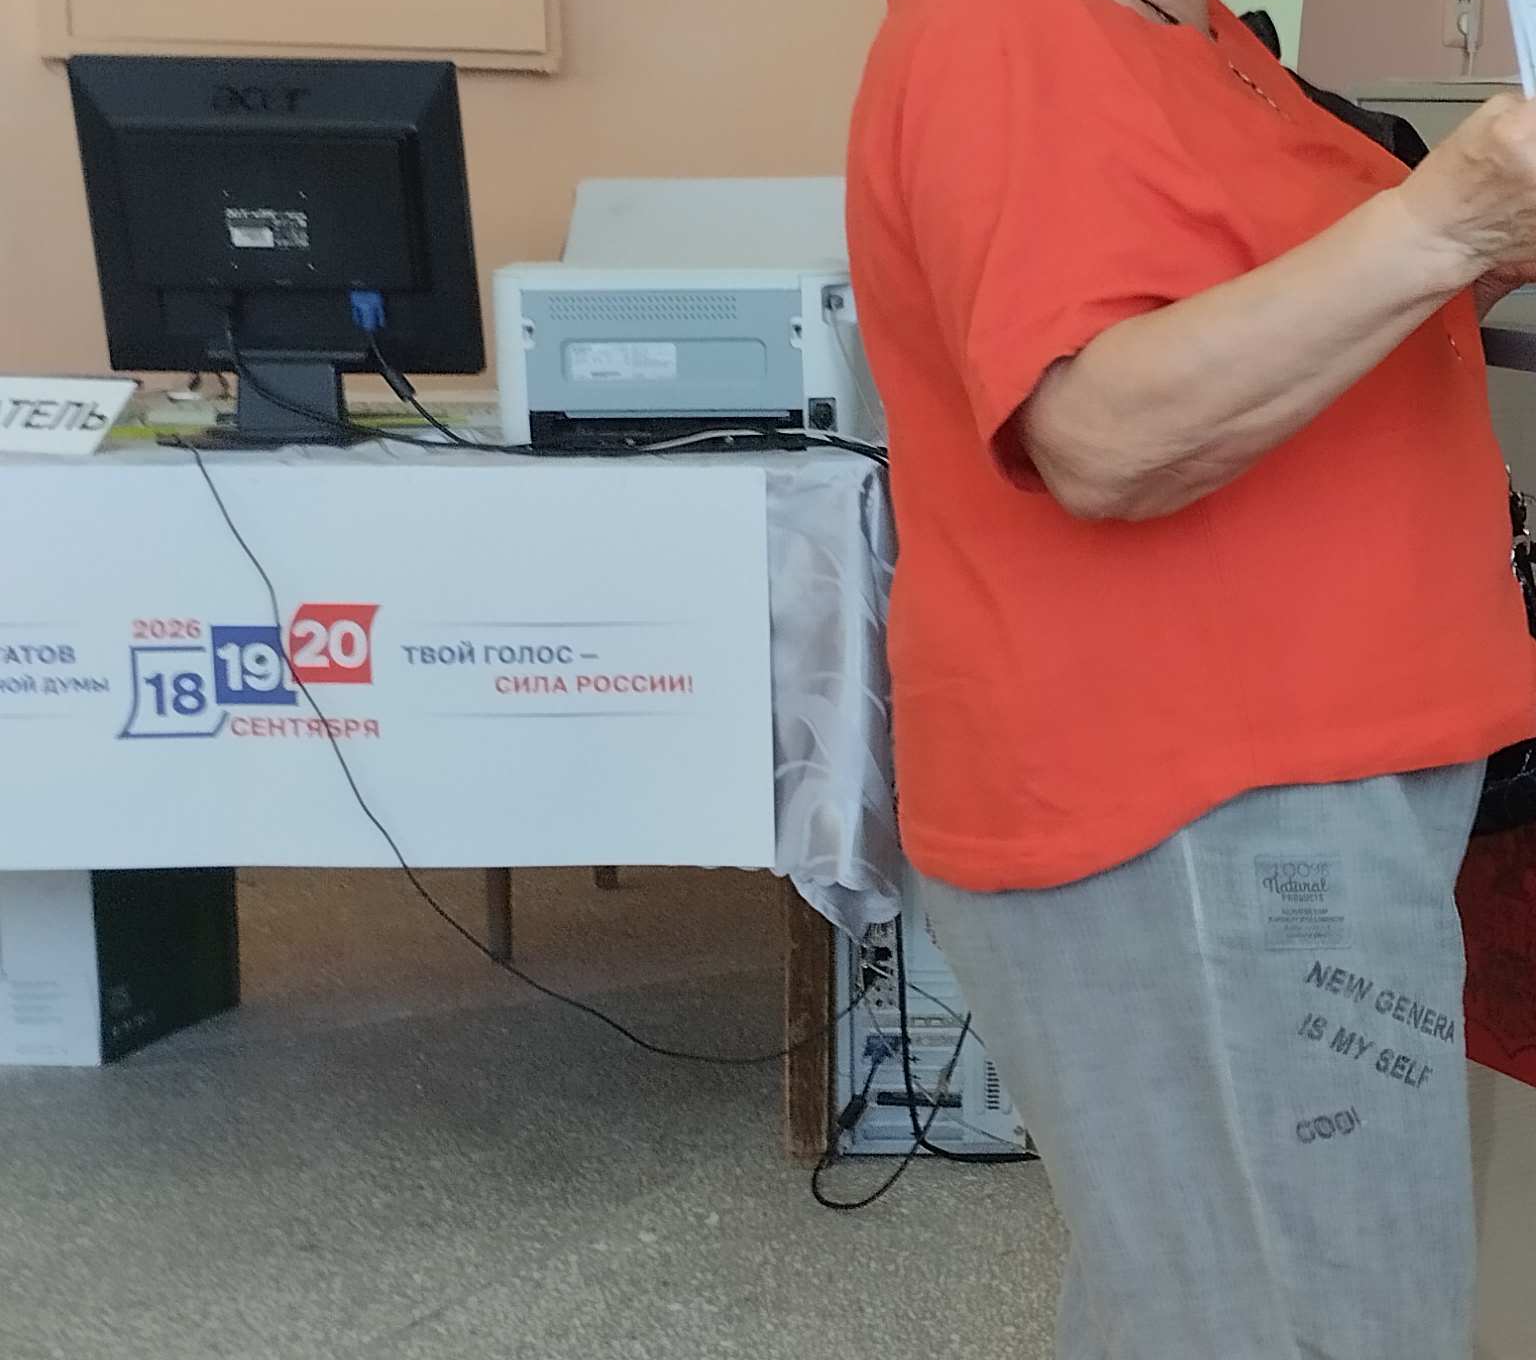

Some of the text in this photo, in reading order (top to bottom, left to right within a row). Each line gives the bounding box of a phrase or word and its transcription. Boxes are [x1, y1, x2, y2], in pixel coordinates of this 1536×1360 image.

[211, 84, 311, 113] acer
[0, 400, 108, 430] ТЕЛЬ
[132, 618, 201, 639] 2026
[401, 641, 475, 665] ТВОЙ
[483, 645, 573, 665] ГОЛОС
[144, 619, 368, 716] 18 19 20
[41, 676, 110, 695] ДУМЫ
[495, 674, 694, 694] СИЛА РОССИИ!
[230, 716, 380, 738] СЕНТЯБРЯ
[1263, 876, 1329, 894] Natural
[1305, 960, 1373, 1003] NEW
[1298, 1013, 1433, 1089] IS MY SELF
